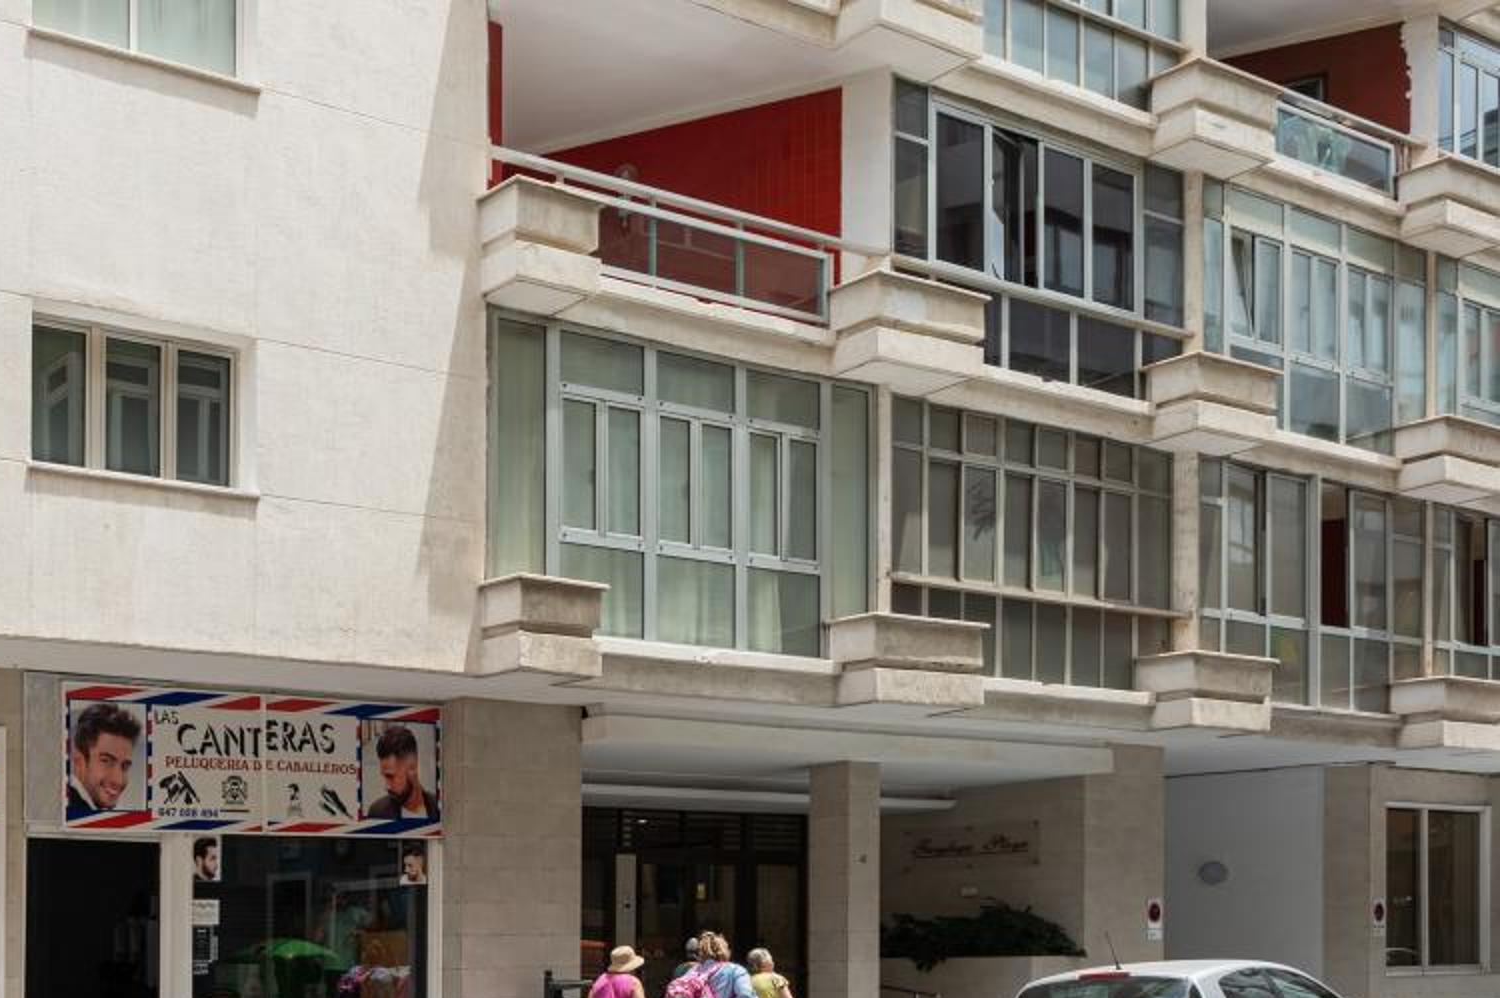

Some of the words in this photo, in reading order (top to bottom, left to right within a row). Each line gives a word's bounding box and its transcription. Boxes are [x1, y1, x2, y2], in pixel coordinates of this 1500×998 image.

[154, 710, 179, 725] LAS
[177, 719, 335, 758] CANTERAS
[164, 755, 248, 771] PELUQUERIA
[277, 758, 357, 775] CABALLEROS
